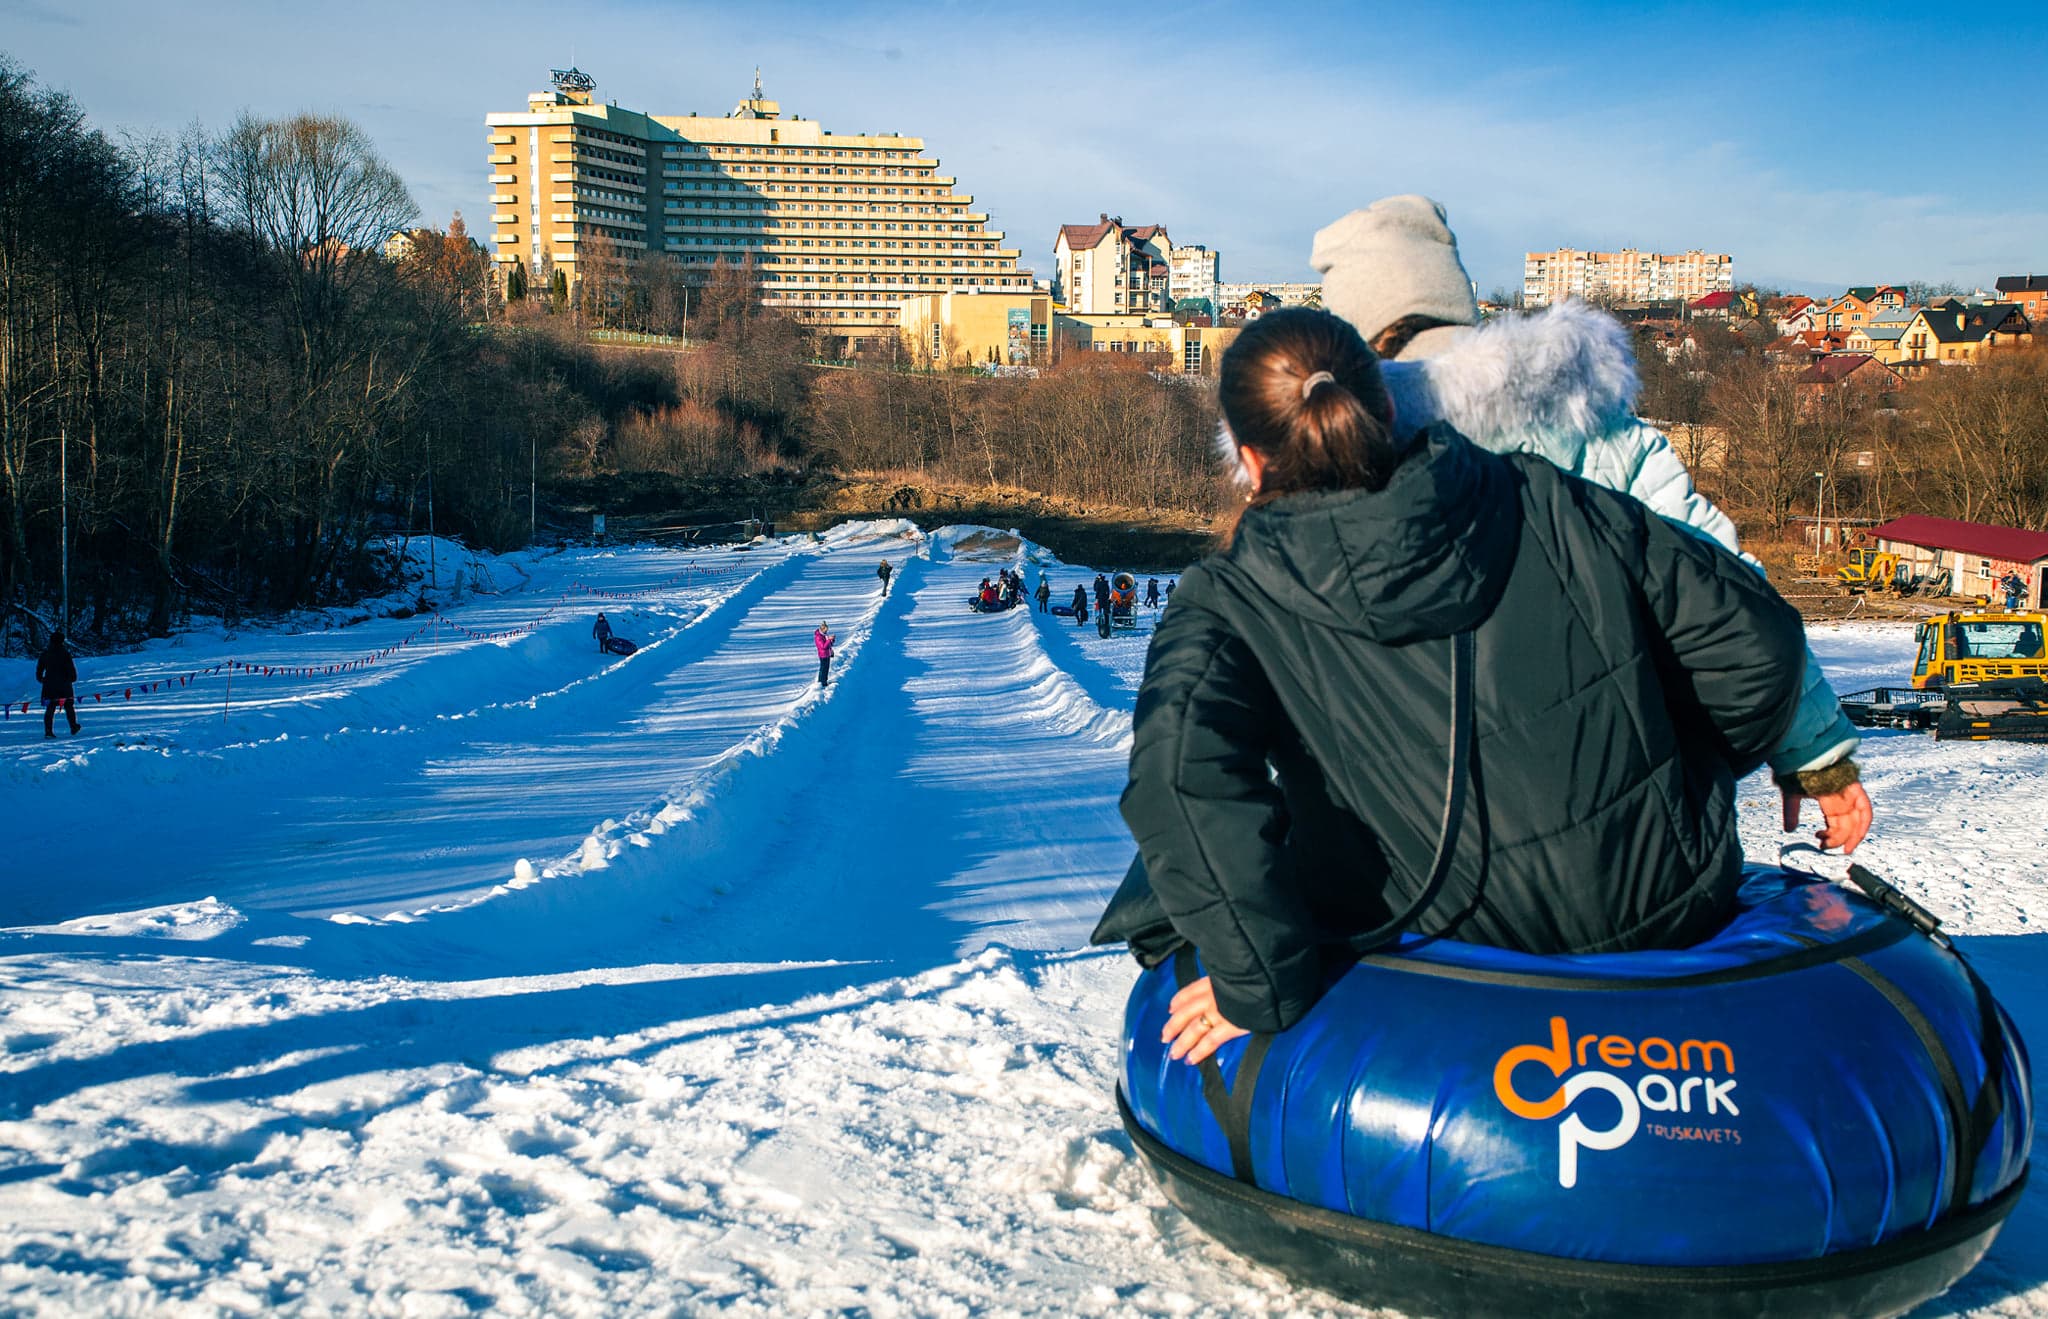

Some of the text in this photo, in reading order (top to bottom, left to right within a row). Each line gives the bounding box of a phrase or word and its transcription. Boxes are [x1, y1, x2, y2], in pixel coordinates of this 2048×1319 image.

[1493, 1016, 1735, 1120] dream
[1559, 1071, 1739, 1188] park
[1646, 1123, 1742, 1145] TRUSKAVETS
